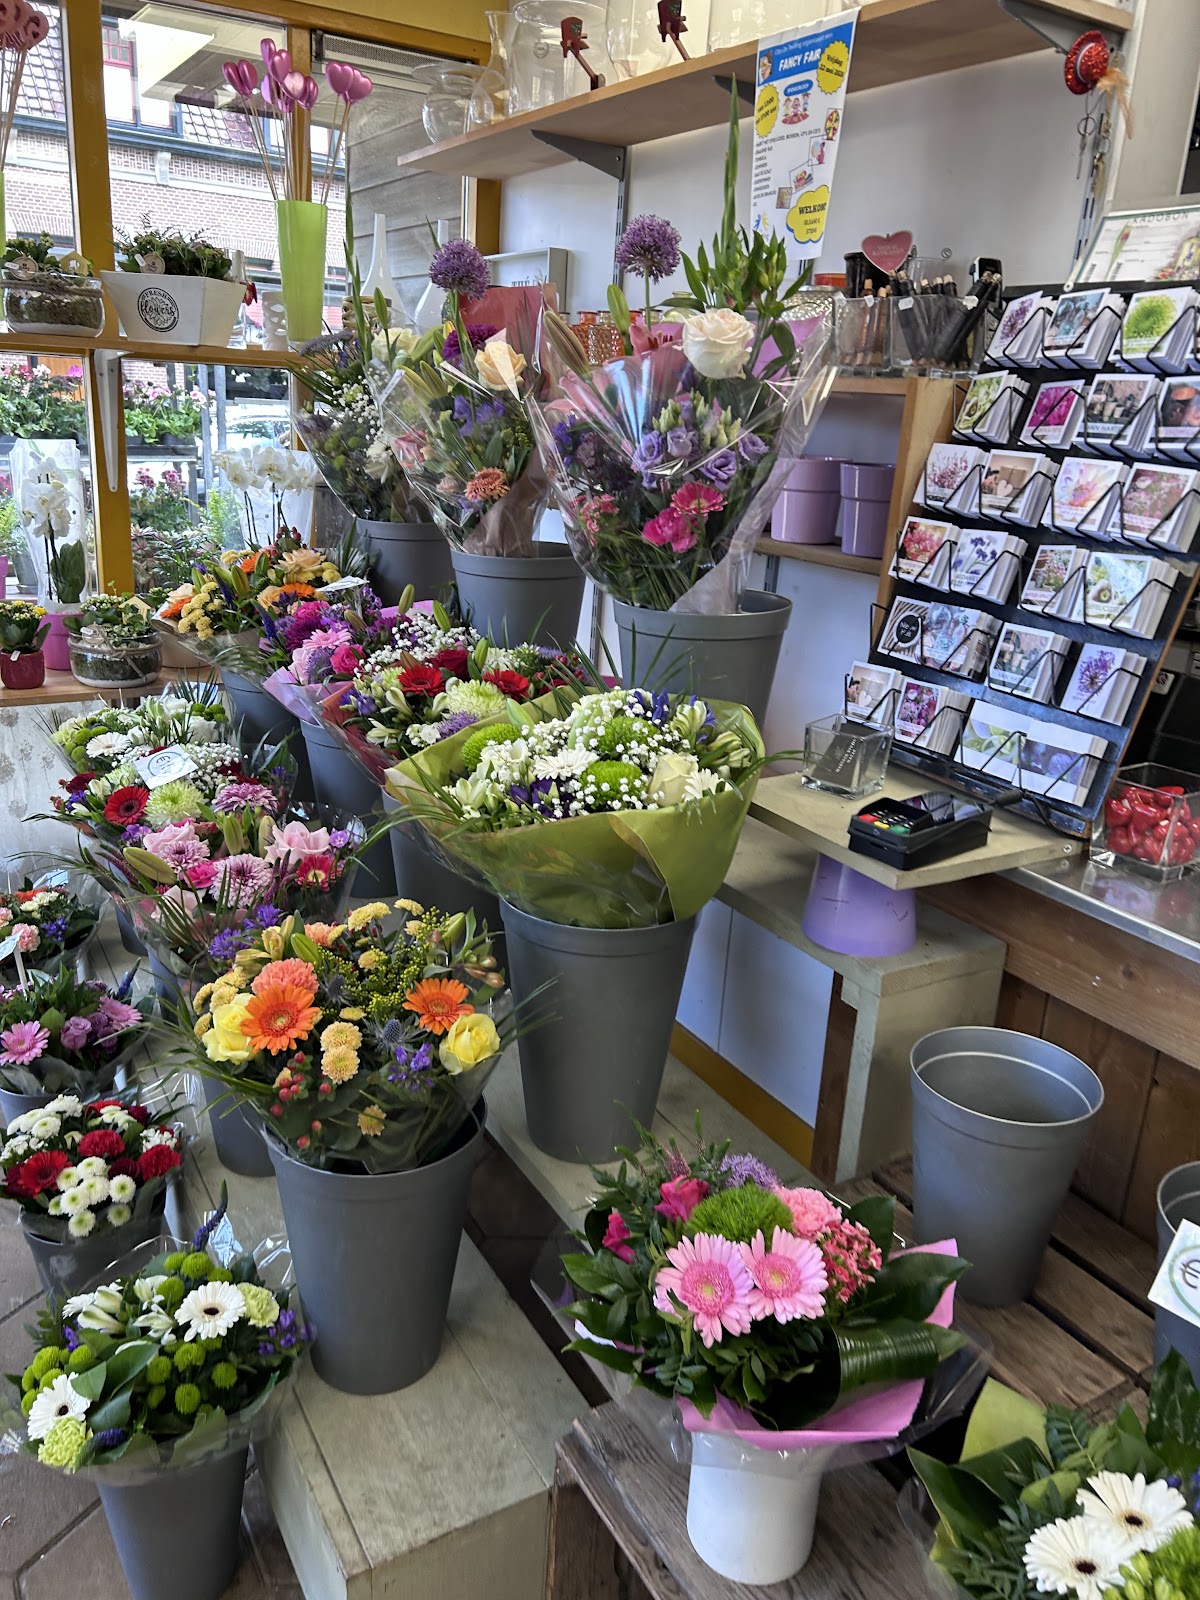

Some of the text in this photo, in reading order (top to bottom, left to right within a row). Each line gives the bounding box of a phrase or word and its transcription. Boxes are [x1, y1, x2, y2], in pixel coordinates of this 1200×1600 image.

[778, 48, 822, 72] FANCY FAIR
[826, 54, 843, 67] Vrijdag
[144, 290, 167, 299] FRESH
[140, 299, 175, 317] flowers
